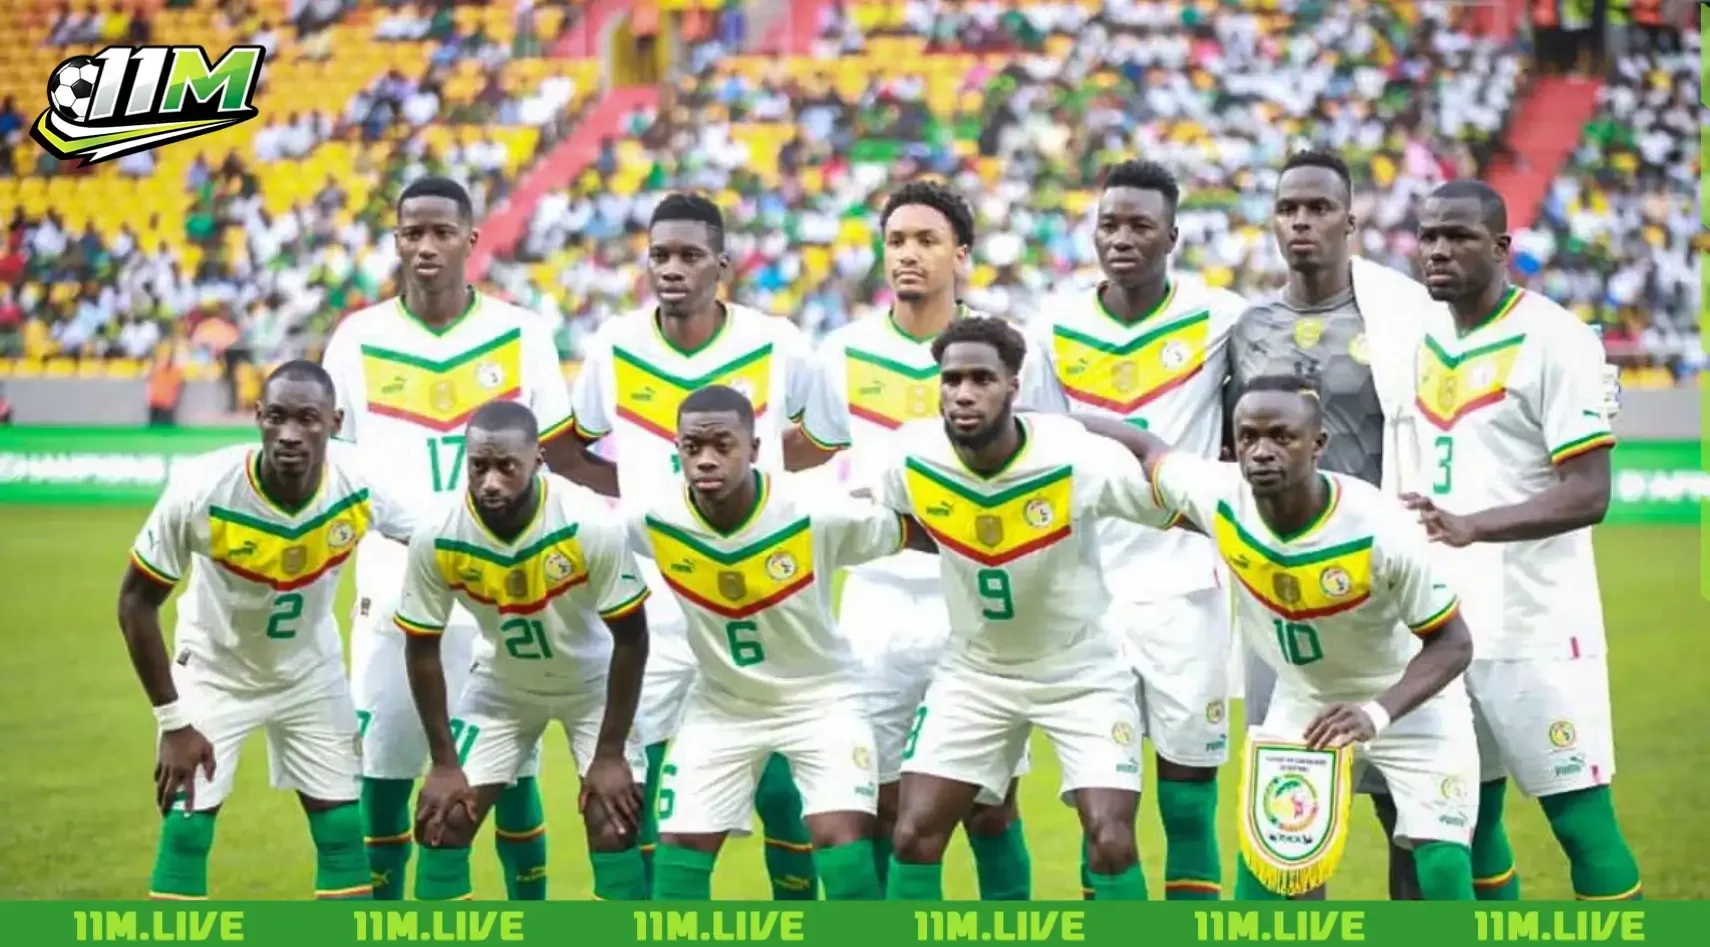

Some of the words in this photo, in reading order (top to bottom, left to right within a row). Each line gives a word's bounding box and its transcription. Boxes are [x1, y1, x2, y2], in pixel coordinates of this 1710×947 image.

[427, 434, 468, 493] 17
[1433, 436, 1453, 495] 3
[267, 592, 305, 641] 2
[976, 567, 1016, 622] 9
[501, 618, 551, 660] 21
[726, 620, 766, 669] 6
[1273, 619, 1323, 665] 10
